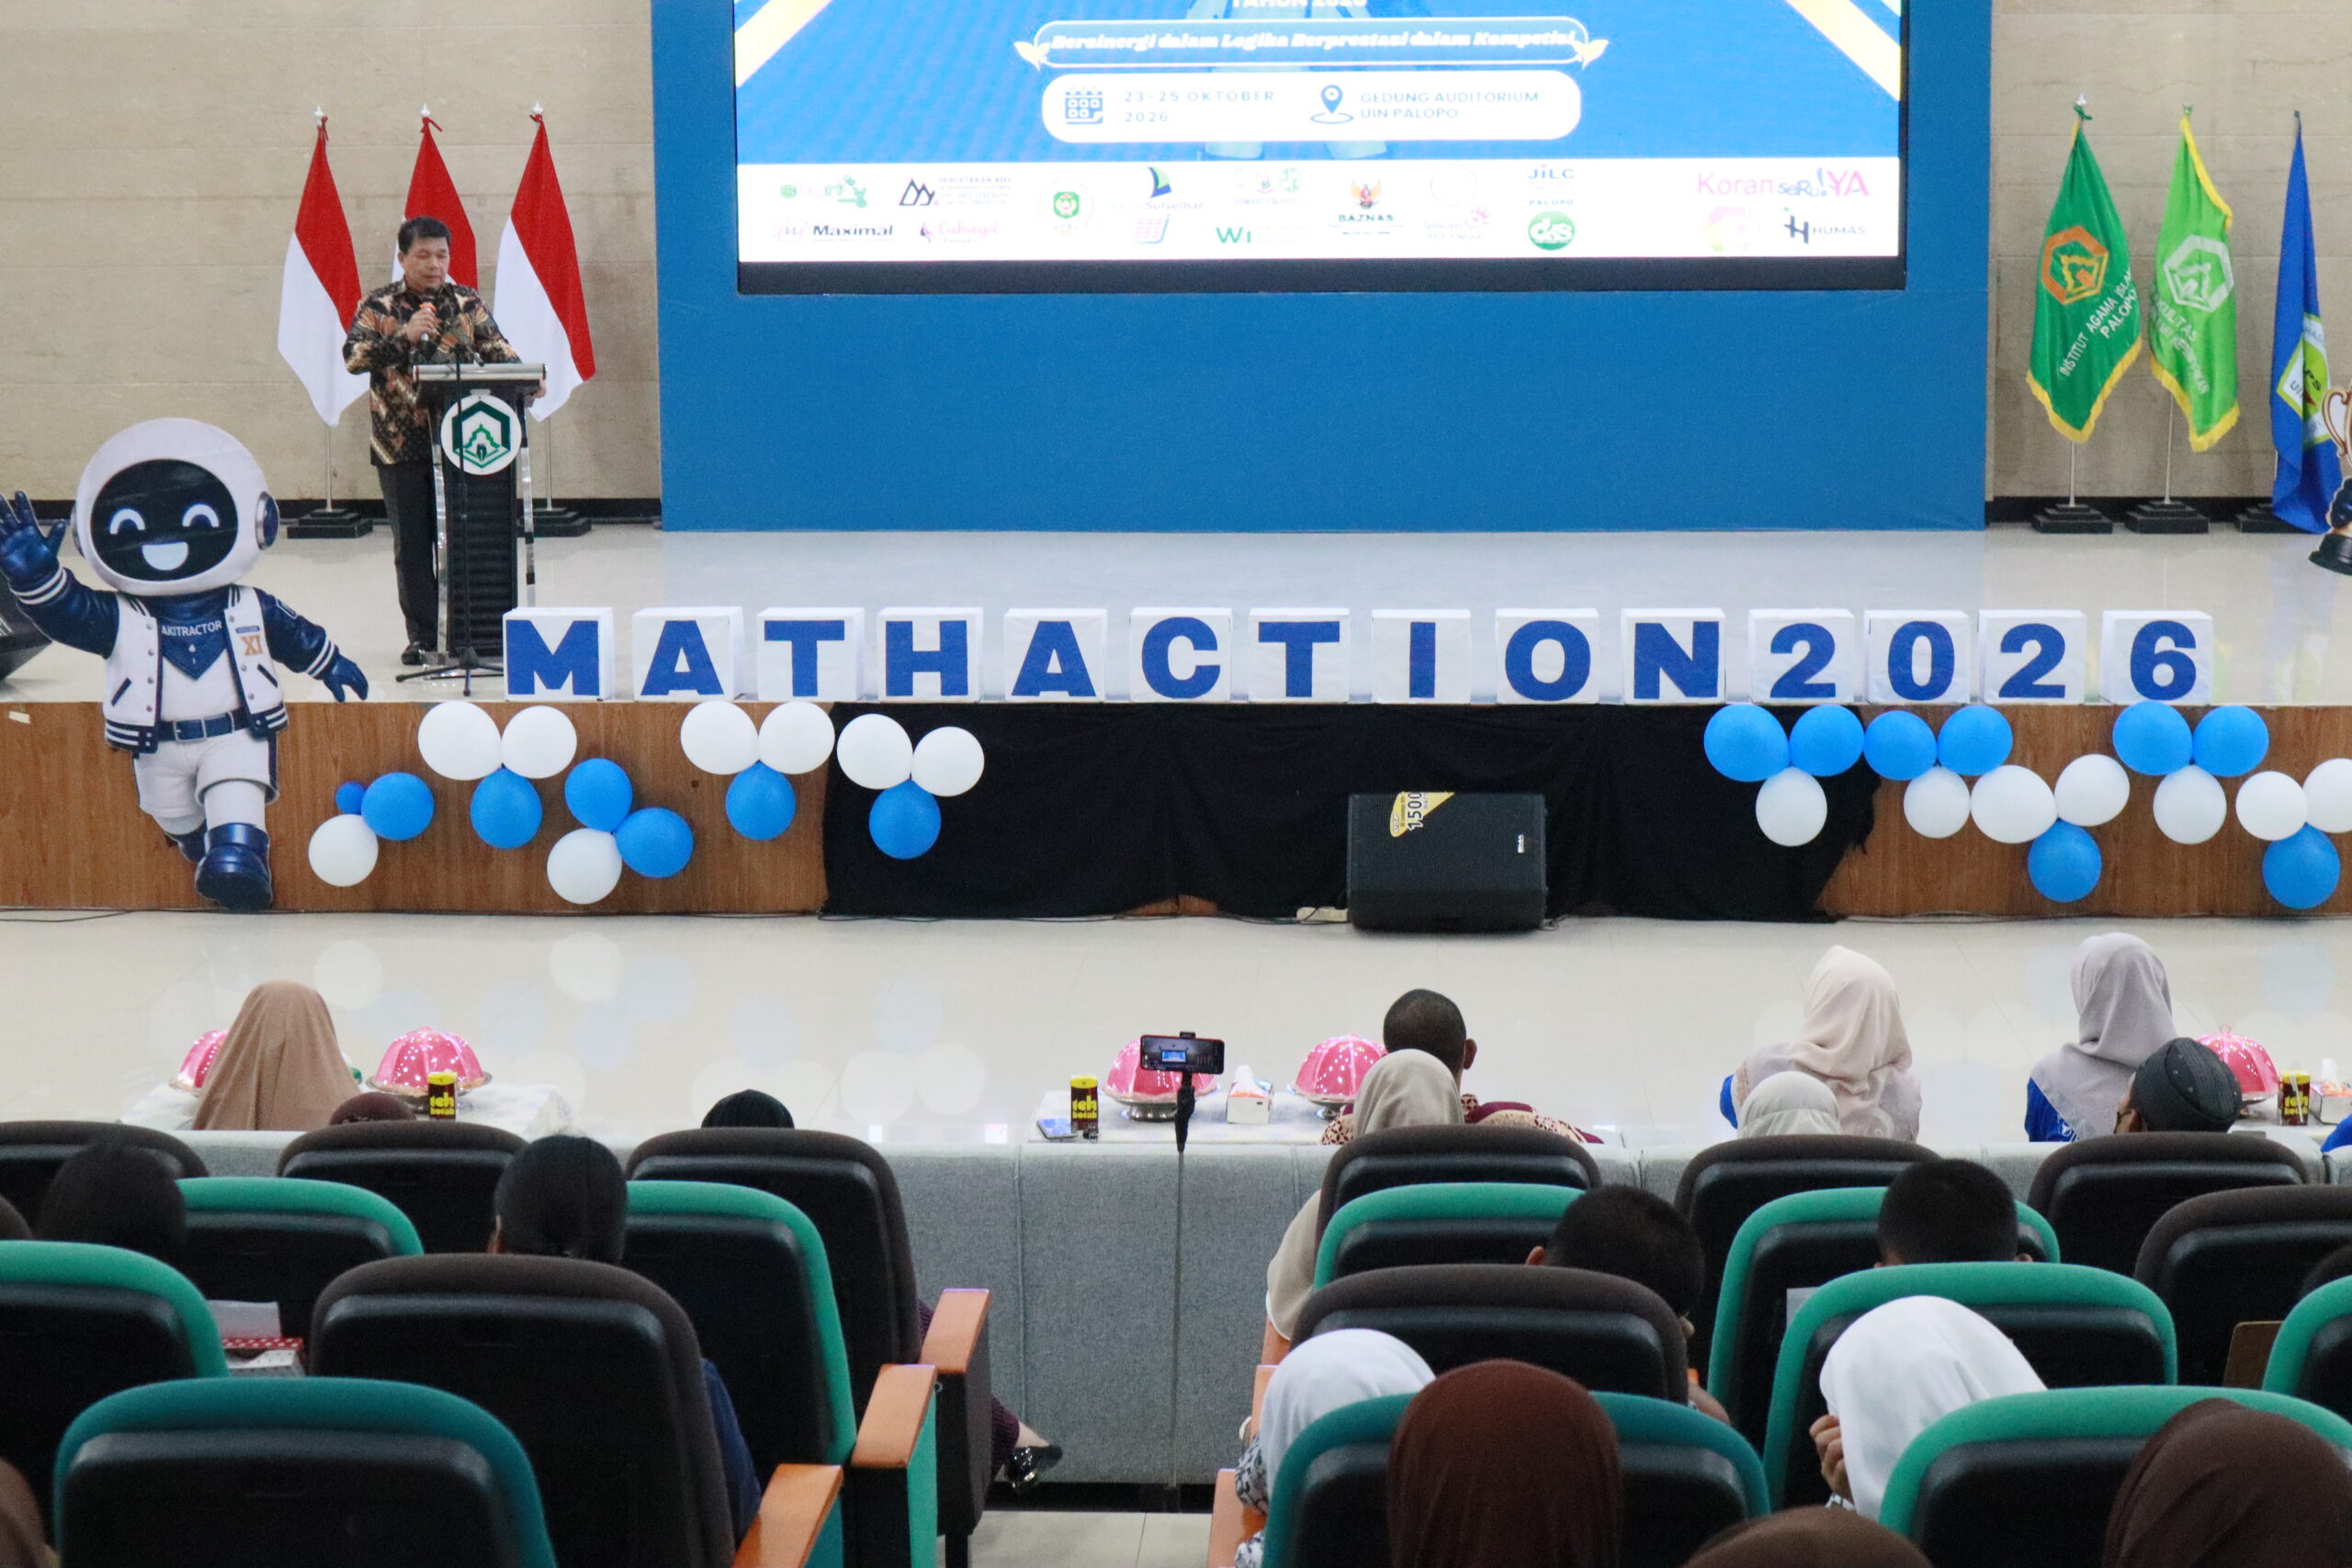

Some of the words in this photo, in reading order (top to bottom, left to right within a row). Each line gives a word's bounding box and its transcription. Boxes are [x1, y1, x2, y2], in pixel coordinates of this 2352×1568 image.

[1222, 34, 1288, 51] Logika
[1184, 91, 1274, 102] OKTOBER
[1361, 92, 1430, 103] GEDUNG
[1434, 92, 1540, 102] AUDITORIUM
[1125, 111, 1169, 122] 2026
[1361, 108, 1388, 118] UIN
[1393, 108, 1458, 118] PALOPO
[1697, 173, 1773, 196] Koran
[1338, 214, 1395, 222] BAZNAS
[812, 224, 893, 236] Maximal
[1812, 227, 1865, 236] HUMAS
[2099, 289, 2137, 339] PALOPO
[2059, 332, 2089, 378] INSTITUT
[2086, 297, 2119, 334] AGAMA
[161, 619, 223, 637] AKITRACTOR
[241, 635, 264, 656] XI
[505, 617, 1721, 702] MATHACTION
[1770, 619, 2197, 701] 2026
[1407, 792, 1424, 831] 1500
[429, 1091, 455, 1108] teh
[1072, 1095, 1098, 1111] teh
